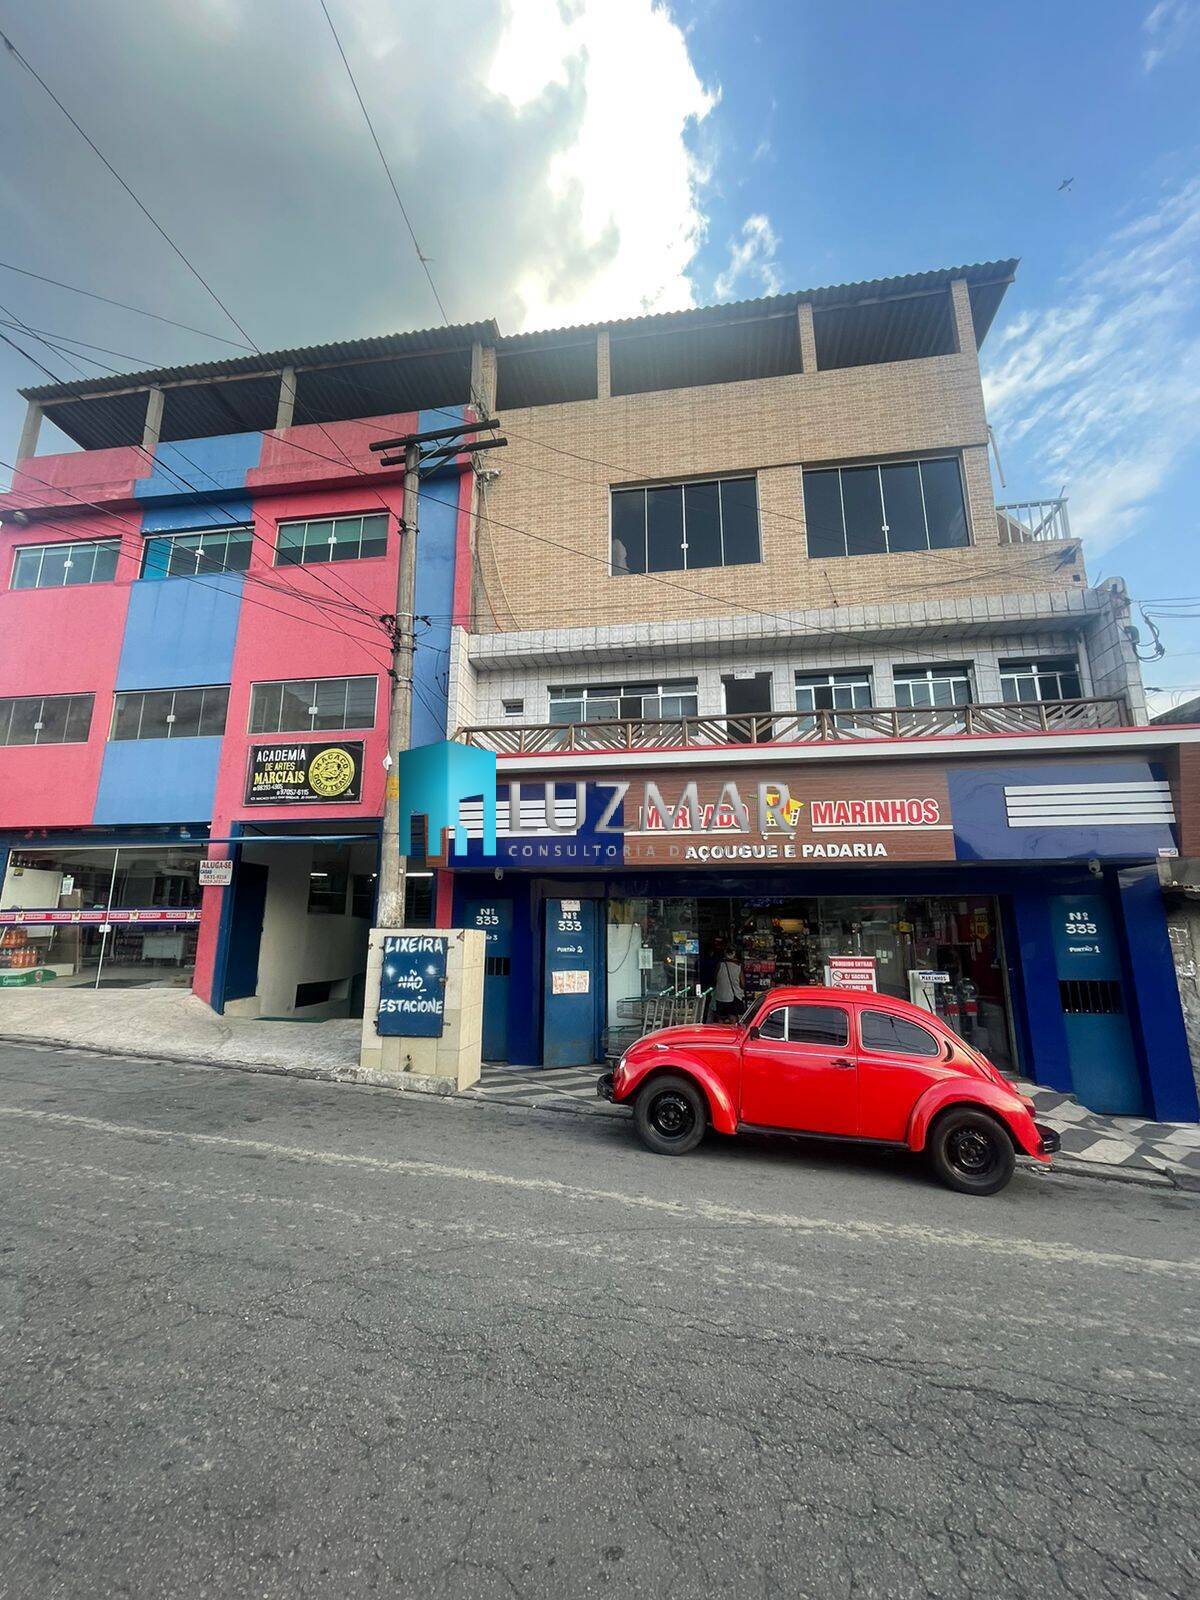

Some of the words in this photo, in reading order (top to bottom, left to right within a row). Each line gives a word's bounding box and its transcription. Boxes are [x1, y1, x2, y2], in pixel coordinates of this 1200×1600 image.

[256, 748, 306, 763] ACADEMIA
[315, 754, 349, 771] MACACO
[264, 763, 274, 771] DE
[275, 762, 296, 771] ARTES
[254, 770, 305, 785] MARCIAIS
[314, 773, 329, 791] GOLD
[811, 799, 940, 826] MARINHOS
[685, 844, 779, 862] AÇOUGUE
[784, 845, 797, 858] E
[802, 843, 888, 858] PADARIA
[476, 915, 499, 925] 333
[557, 920, 582, 931] 333
[1065, 923, 1097, 934] 333
[385, 936, 443, 954] LIXEIRA
[1094, 945, 1101, 953] 1
[397, 969, 424, 990] NÃO
[378, 996, 443, 1014] ESTACIONE
